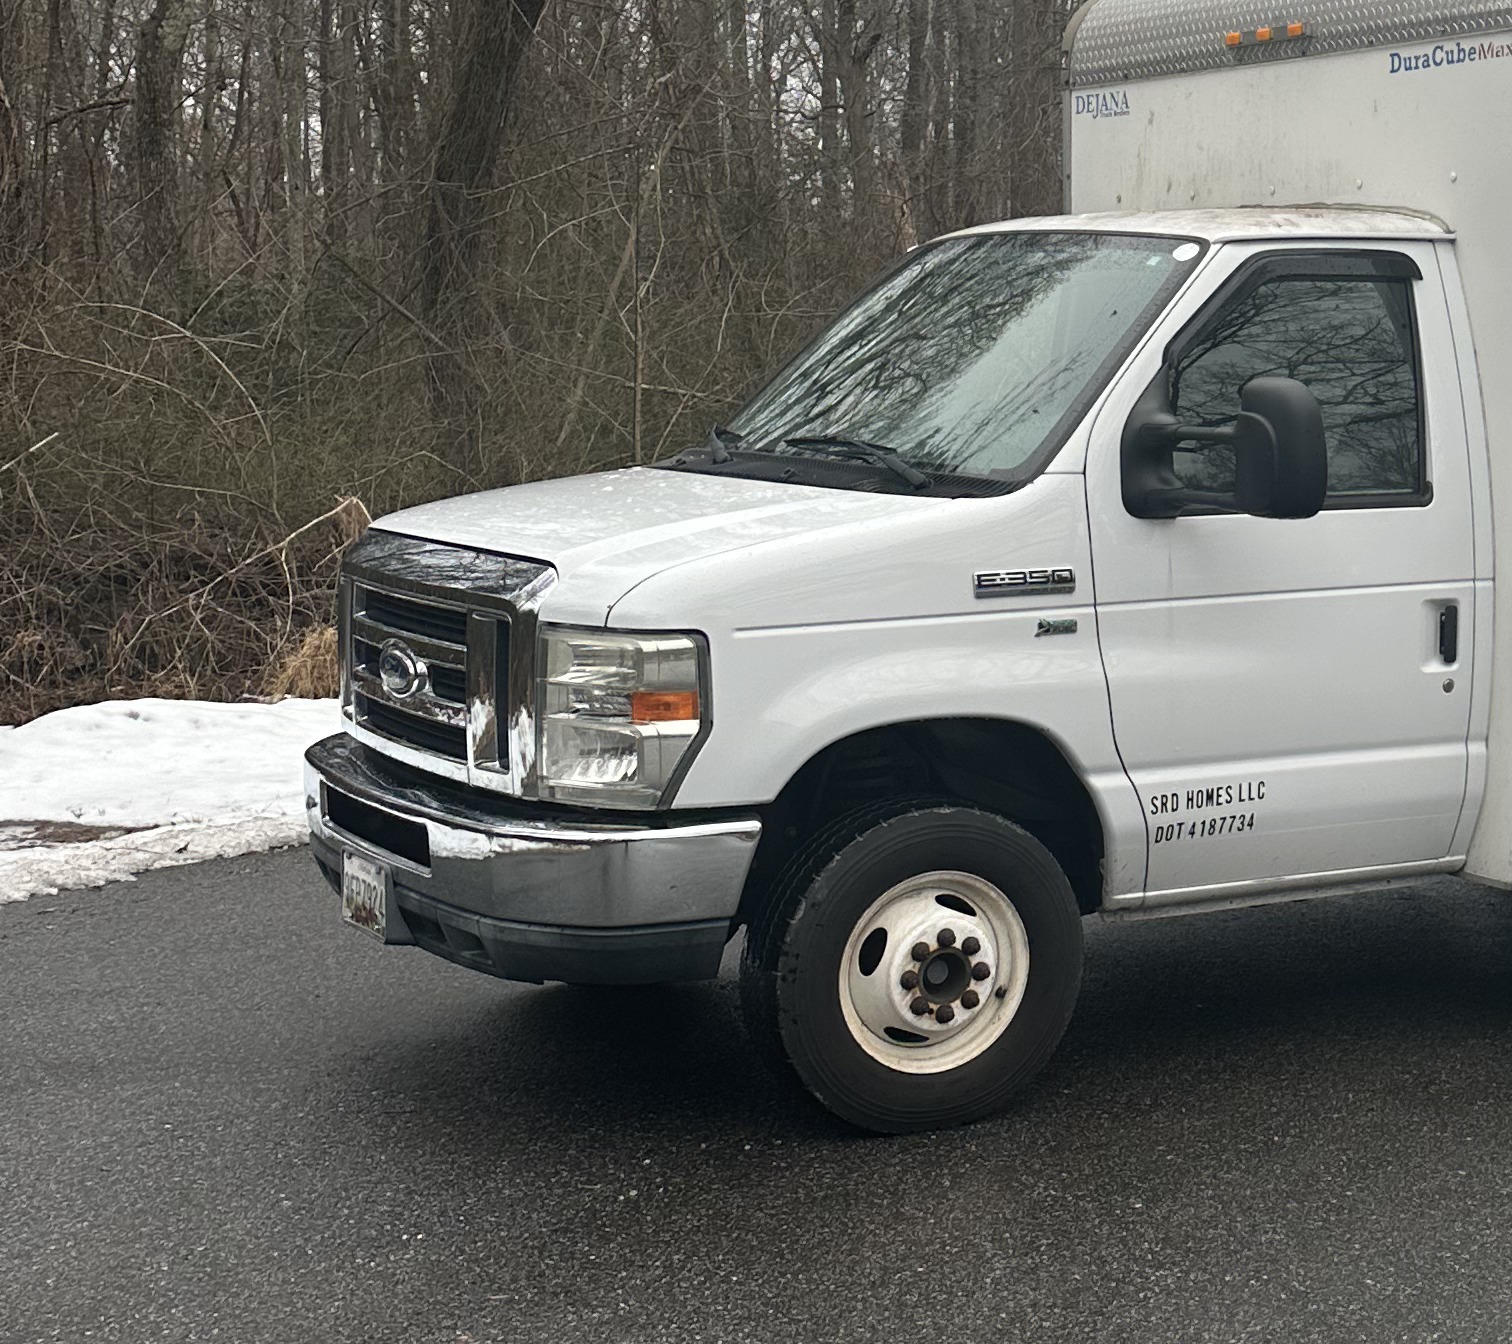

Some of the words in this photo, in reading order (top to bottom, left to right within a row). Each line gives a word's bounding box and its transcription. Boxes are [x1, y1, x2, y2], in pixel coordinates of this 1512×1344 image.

[1075, 90, 1130, 119] DEJANA
[1150, 792, 1179, 815] SRD
[1186, 785, 1233, 810] HOMES
[1238, 780, 1266, 803] LLC
[1154, 822, 1186, 844] DOT
[1188, 812, 1255, 839] 4187734
